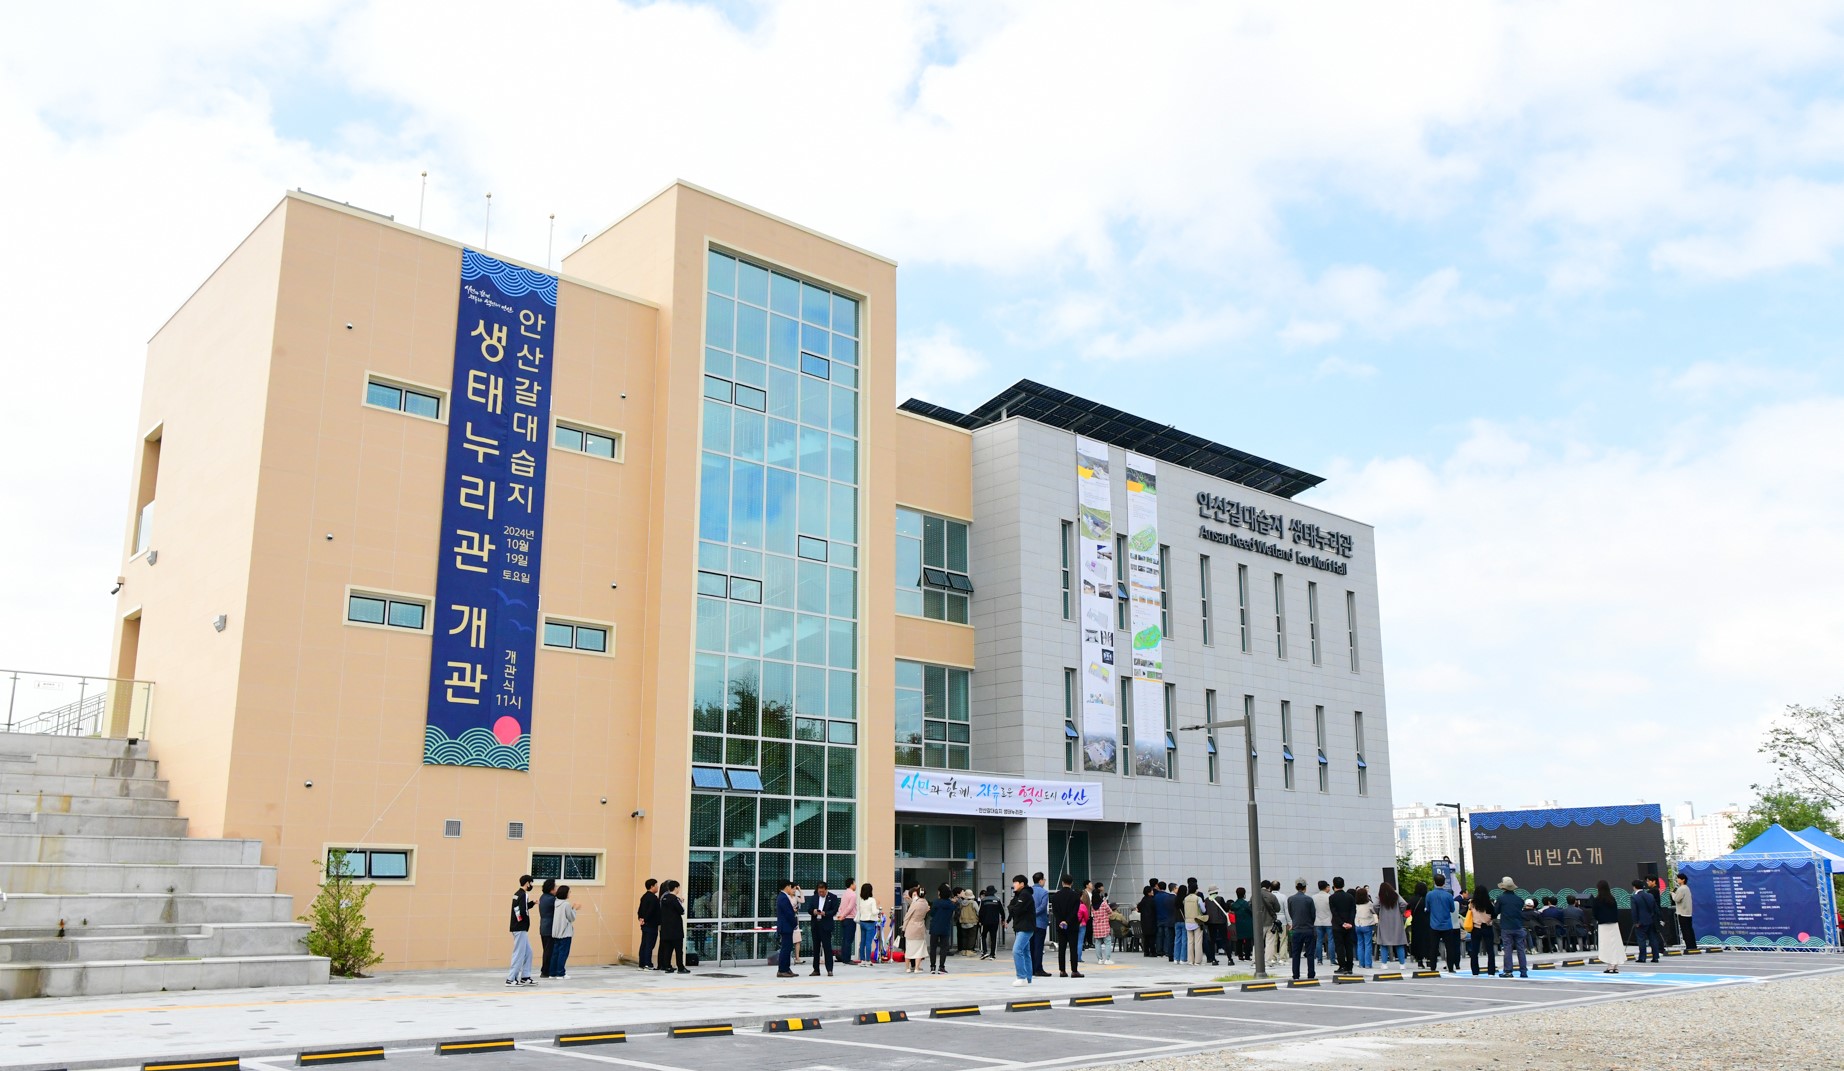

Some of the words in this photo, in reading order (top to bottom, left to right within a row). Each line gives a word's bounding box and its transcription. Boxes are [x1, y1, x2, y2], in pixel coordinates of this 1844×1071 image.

[507, 309, 546, 513] 안산갈대습지
[453, 319, 507, 573] 생태누리관
[503, 526, 534, 540] 2024년
[1196, 491, 1284, 539] 안산갈대습지
[1288, 518, 1354, 559] 생태누리관
[505, 553, 528, 566] 19일
[506, 538, 529, 552] 10월
[1199, 525, 1230, 546] Ansan
[1229, 533, 1256, 552] Reed
[1254, 539, 1293, 562] Wetland
[1330, 560, 1347, 575] Hall
[502, 569, 530, 583] 토요일
[444, 604, 488, 705] 개관
[502, 650, 517, 693] 개관식
[495, 694, 522, 709] 11시
[901, 772, 941, 801] 시민과
[976, 783, 1013, 807] 자유로운
[1018, 785, 1057, 807] 혁신도시
[1061, 787, 1089, 806] 안산
[1527, 847, 1603, 866] 내빈소개
